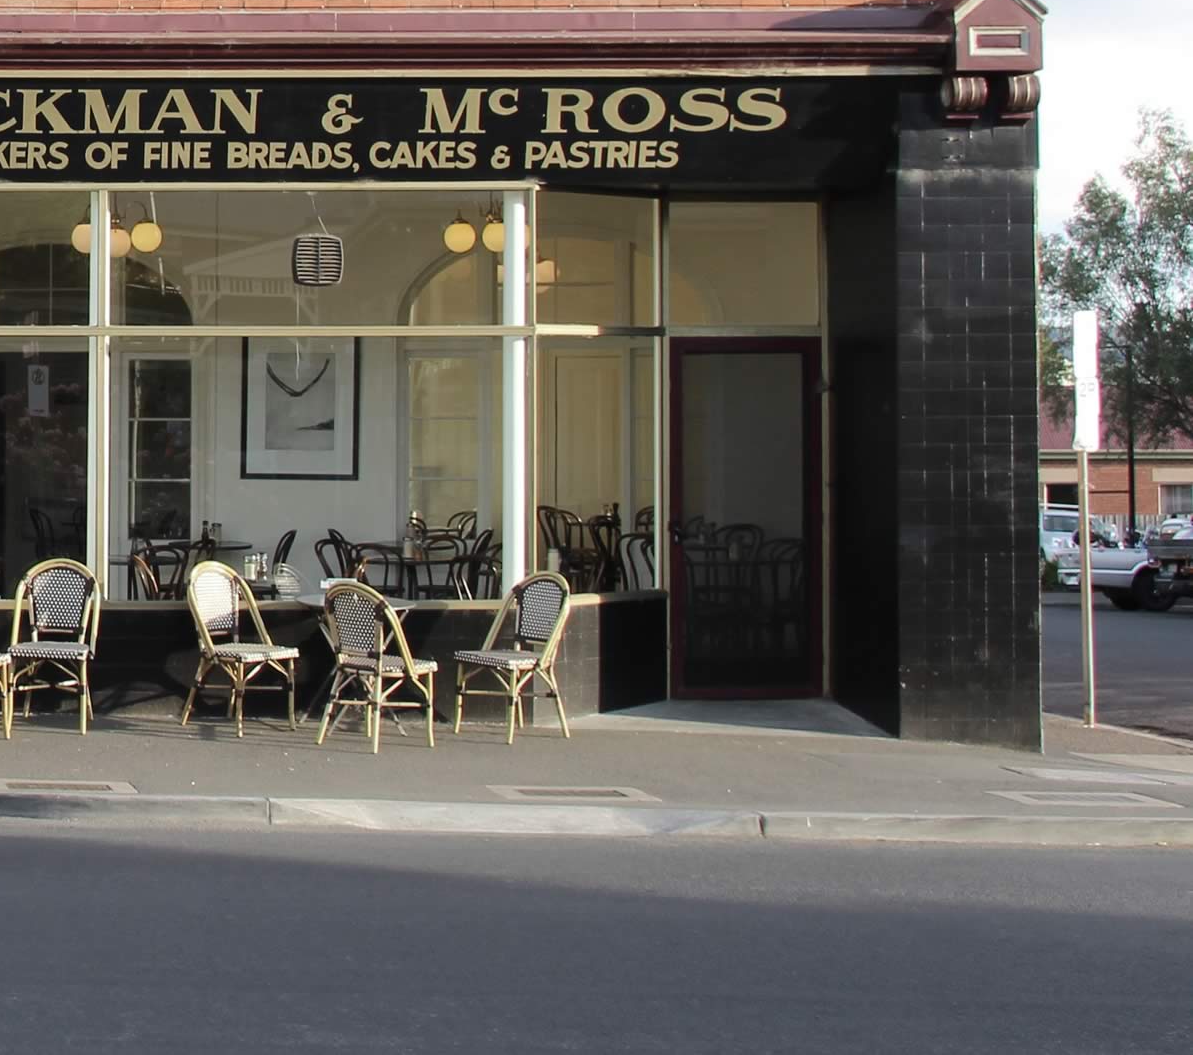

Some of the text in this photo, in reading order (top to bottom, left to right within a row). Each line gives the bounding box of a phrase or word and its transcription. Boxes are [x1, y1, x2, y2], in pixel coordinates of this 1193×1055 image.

[321, 93, 364, 135] &
[84, 141, 129, 170] OF
[143, 141, 212, 170] FINE
[226, 141, 360, 173] BREADS,
[368, 141, 477, 170] CAKES
[490, 144, 511, 170] &
[524, 140, 679, 170] PASTRIES
